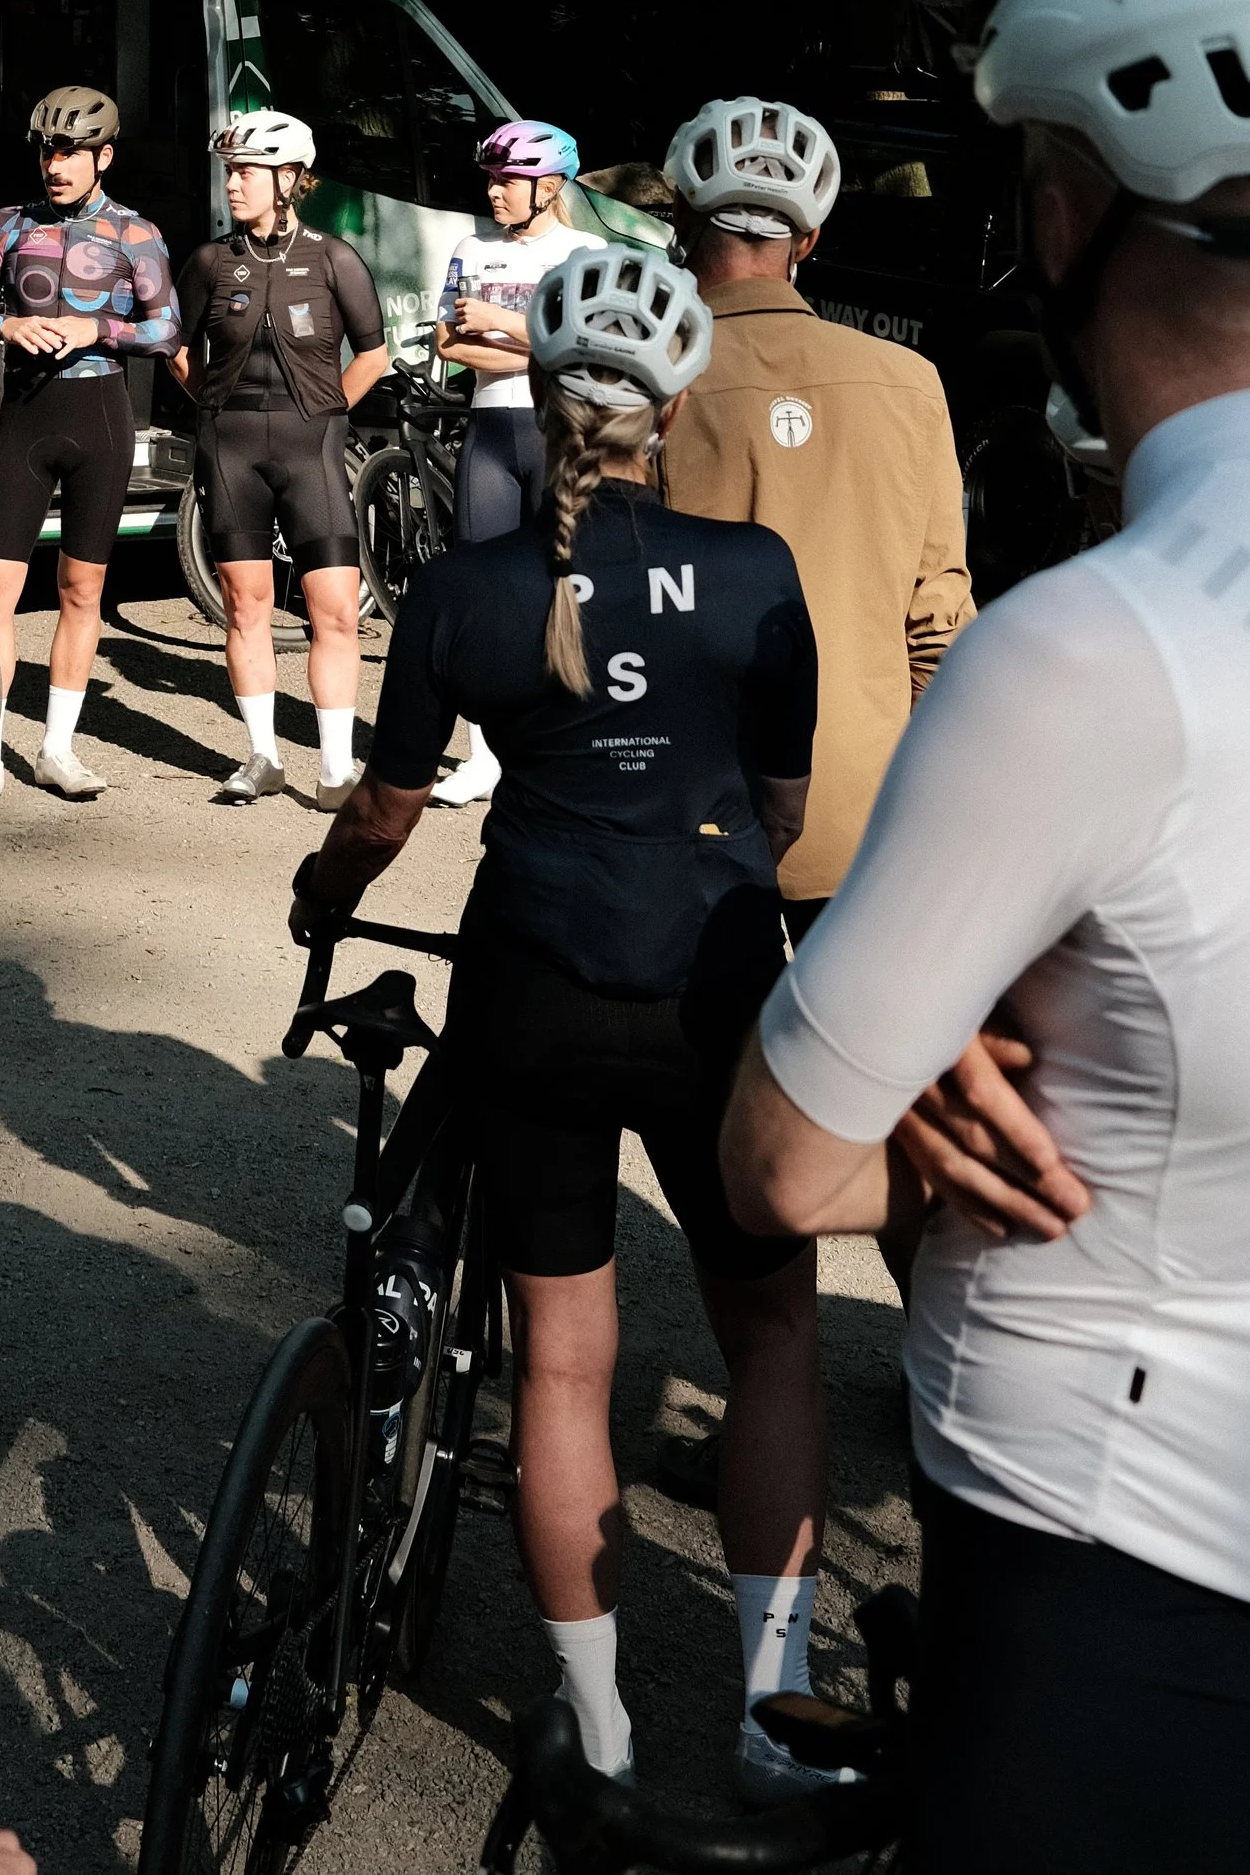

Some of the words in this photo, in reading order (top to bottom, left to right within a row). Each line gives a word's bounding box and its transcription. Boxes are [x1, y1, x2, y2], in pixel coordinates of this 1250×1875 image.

[820, 299, 869, 332] WAY
[873, 312, 924, 346] OUT
[647, 563, 696, 615] N
[607, 651, 648, 702] S
[591, 736, 672, 749] INTERNATIONAL
[609, 748, 655, 759] CYCLING
[618, 761, 647, 772] CLUB
[763, 1613, 775, 1623] P
[788, 1613, 799, 1624] N
[776, 1628, 787, 1638] S
